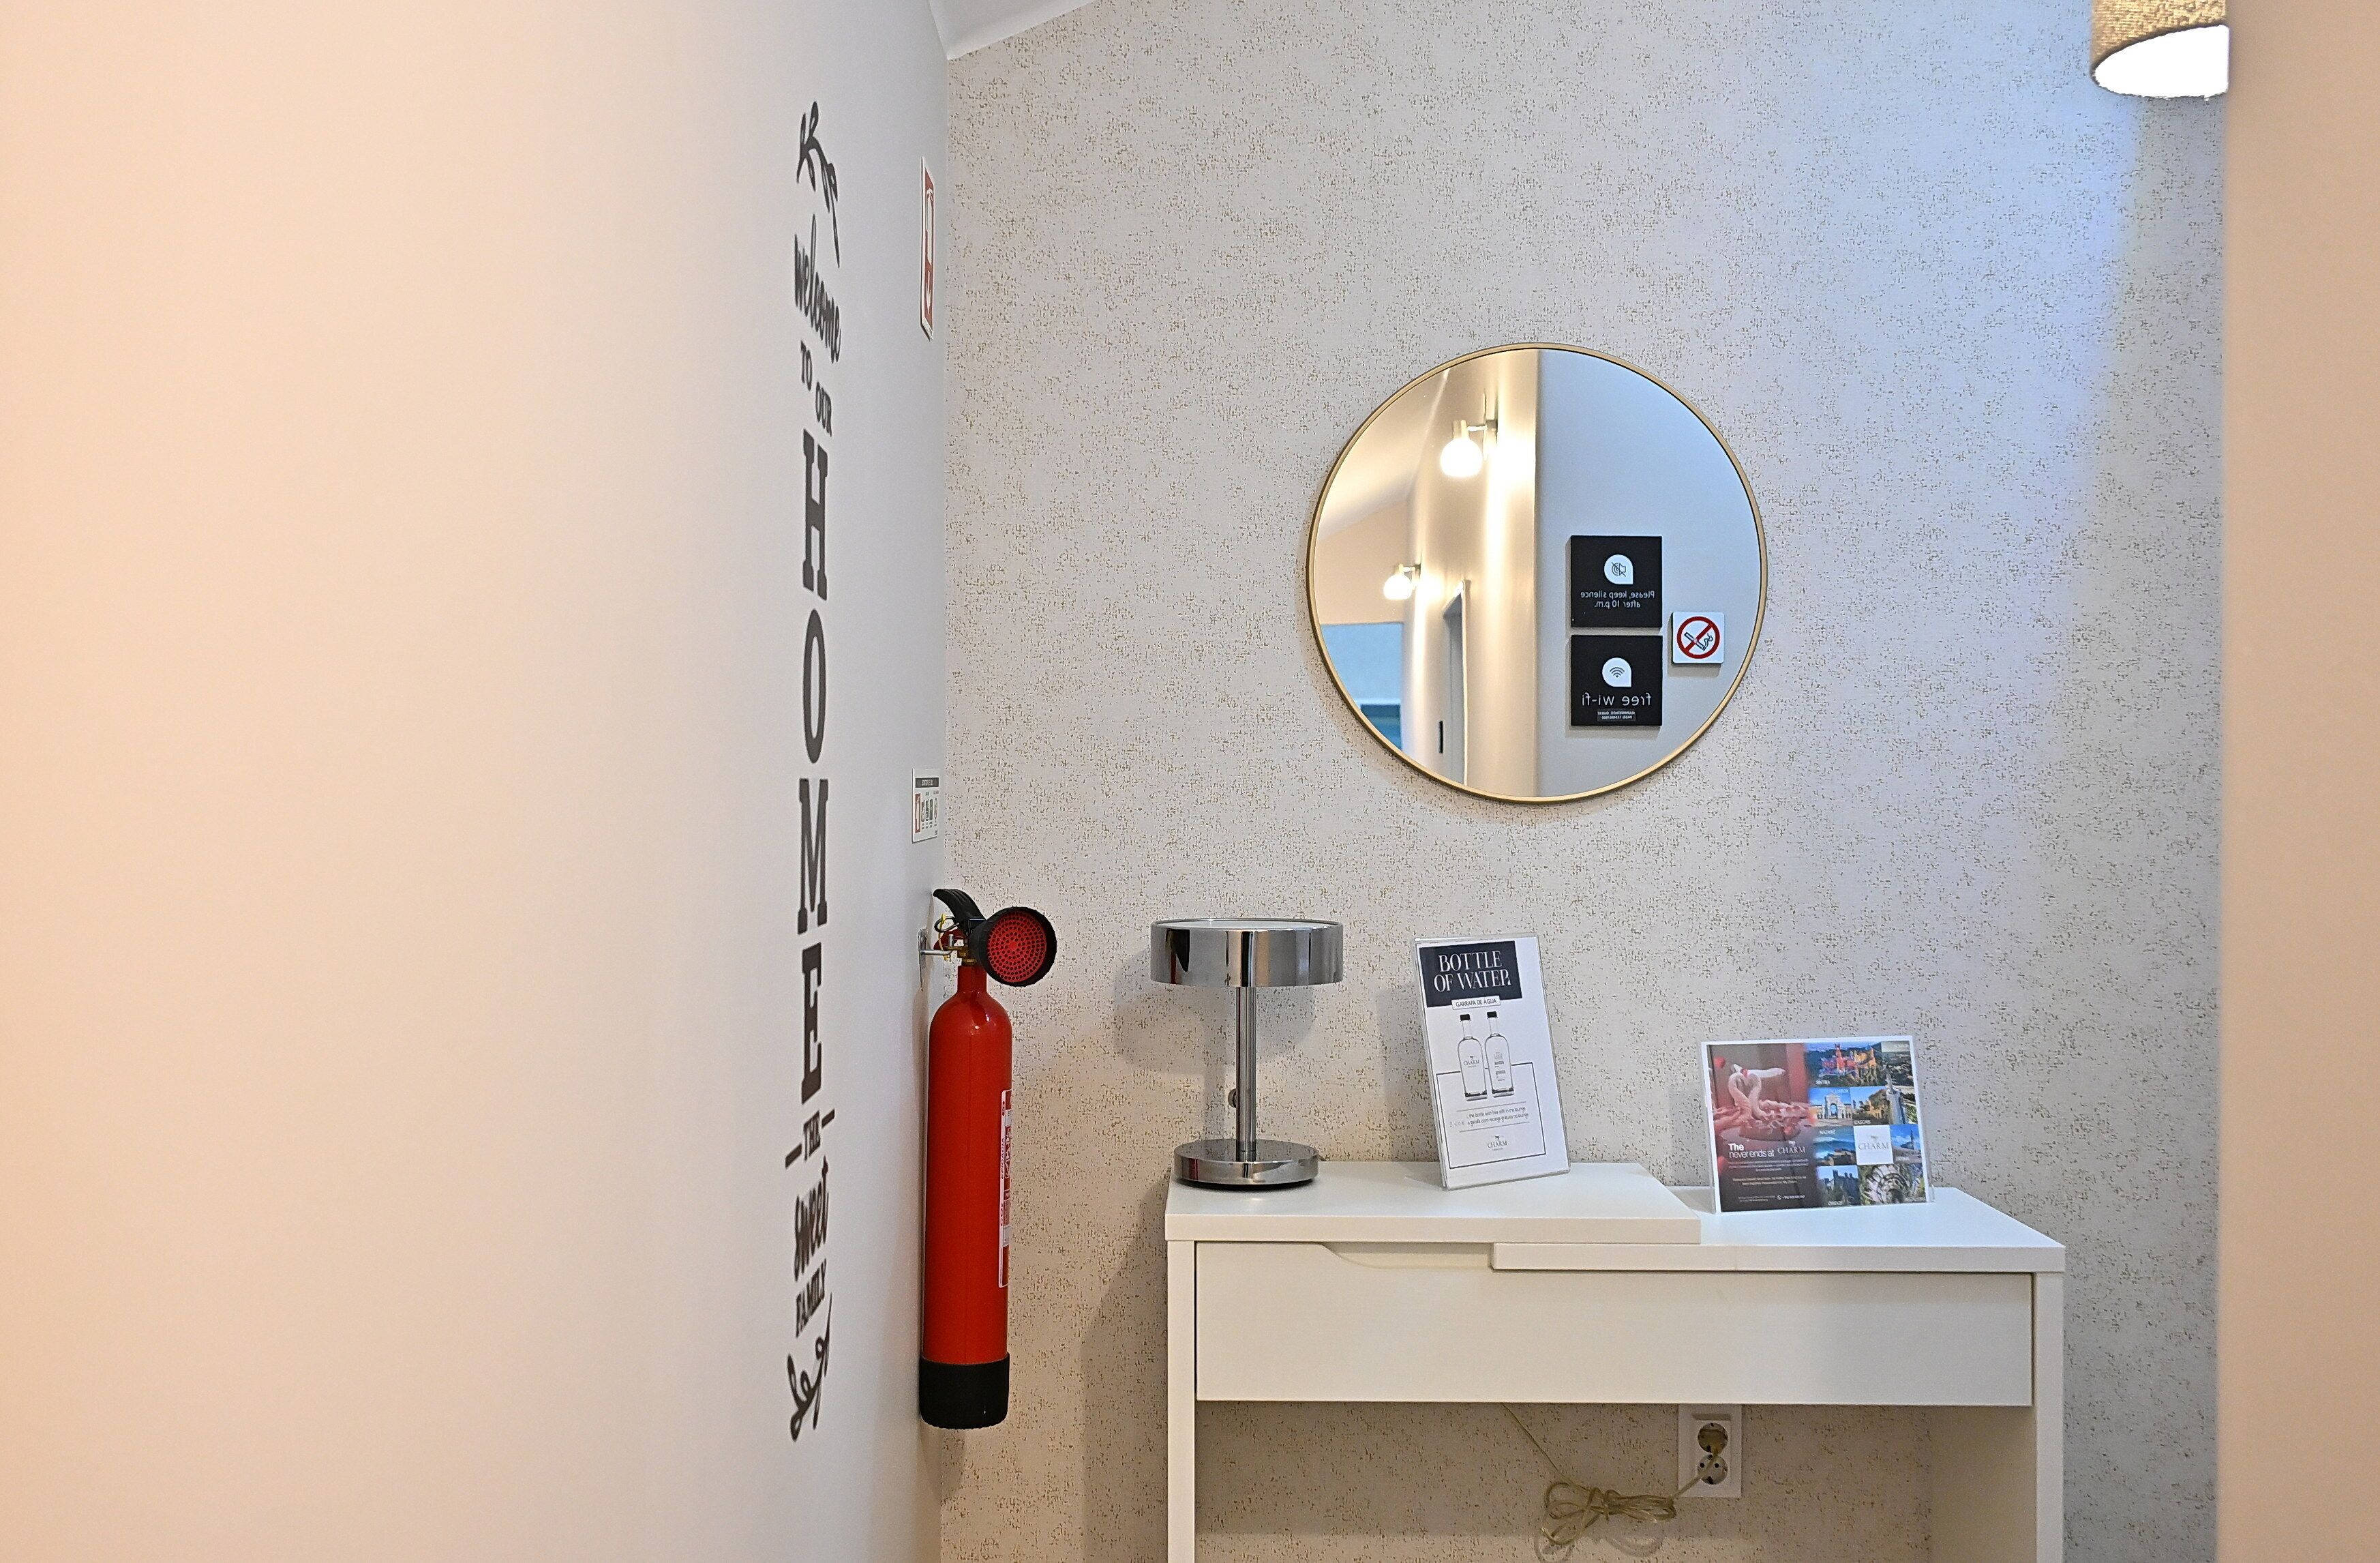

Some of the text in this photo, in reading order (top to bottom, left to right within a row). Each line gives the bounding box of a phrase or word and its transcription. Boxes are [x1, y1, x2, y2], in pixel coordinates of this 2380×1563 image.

[794, 213, 841, 363] welcome
[800, 340, 832, 438] TO OUR
[798, 428, 829, 1105] HOME
[1438, 950, 1503, 972] BOTTLE
[1434, 968, 1511, 992] OF WATER
[1487, 1140, 1507, 1149] CHARM
[1728, 1143, 1745, 1151] The
[1729, 1146, 1806, 1159] never ends at CHARM
[1858, 1142, 1889, 1150] CHARM
[794, 1155, 829, 1281] sweet
